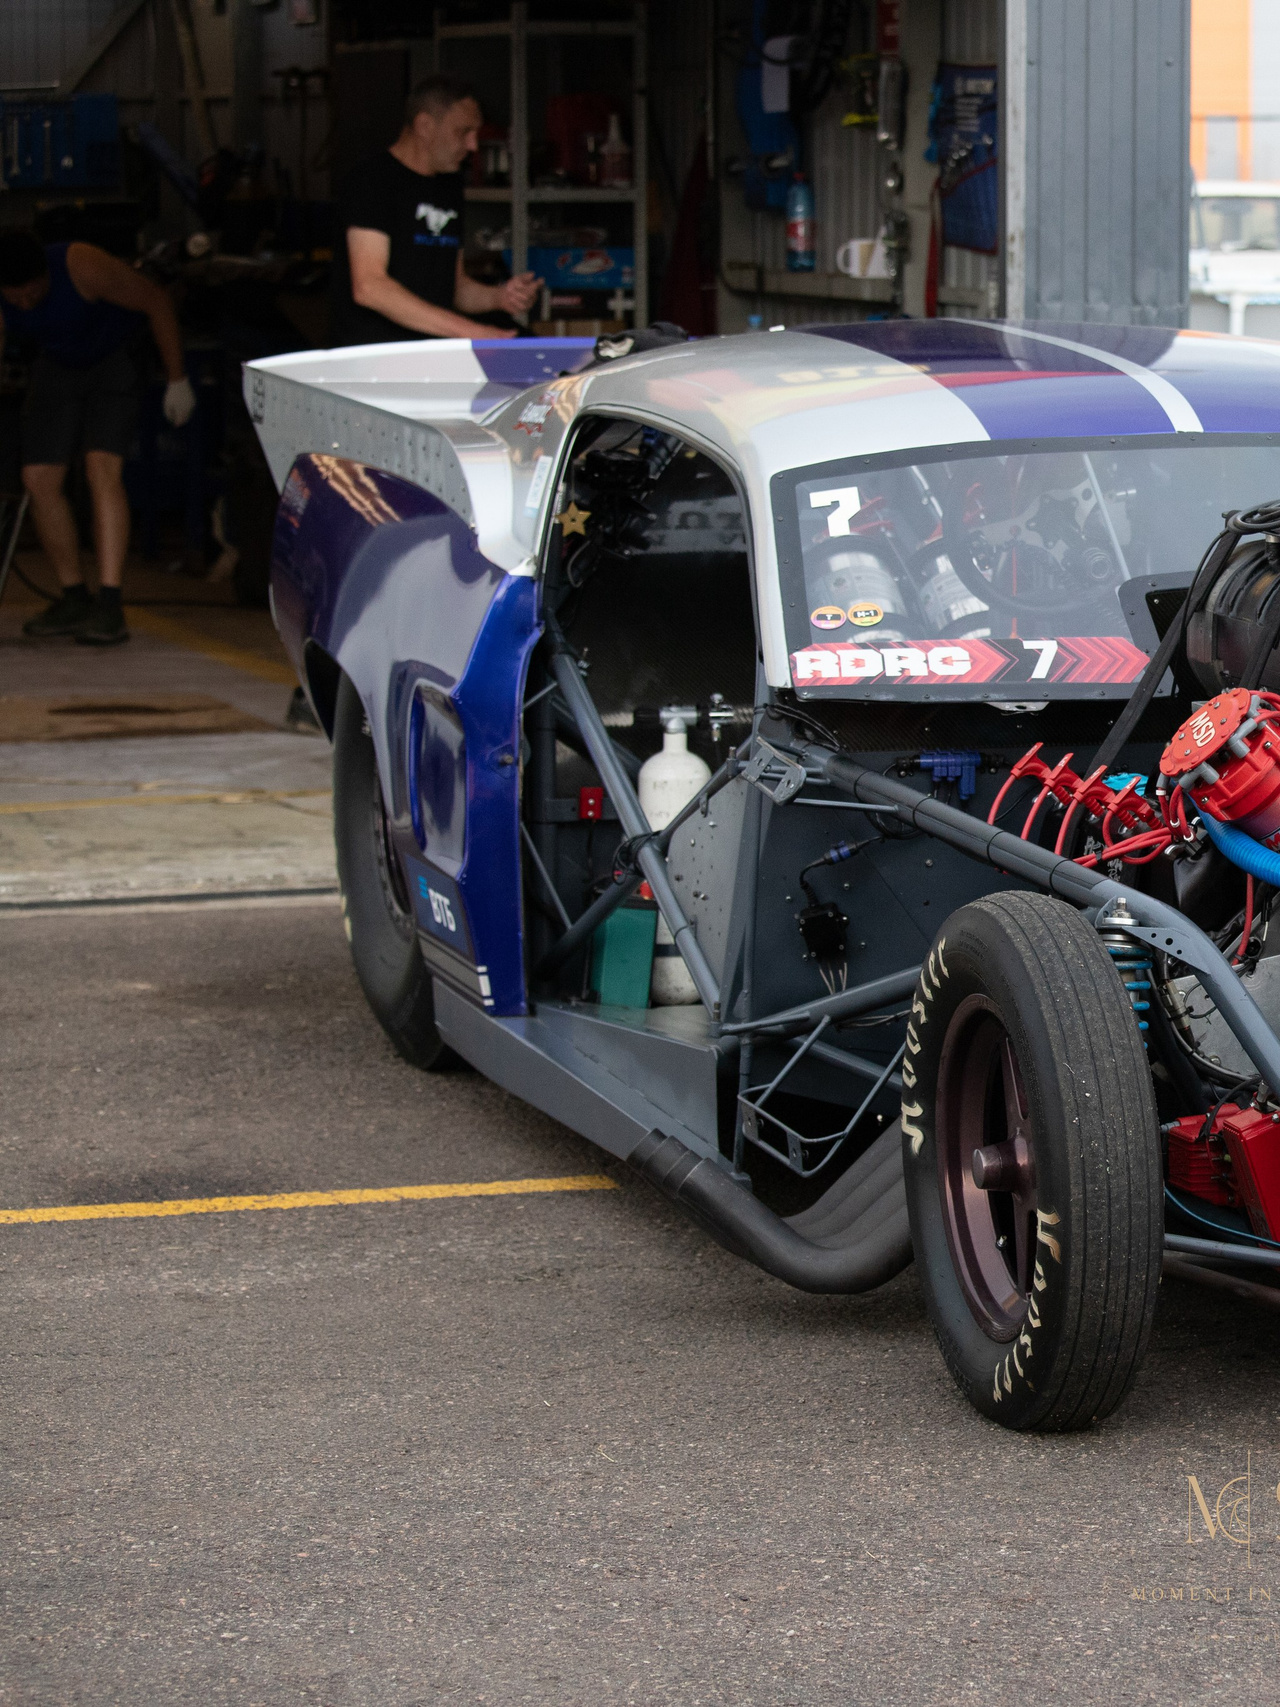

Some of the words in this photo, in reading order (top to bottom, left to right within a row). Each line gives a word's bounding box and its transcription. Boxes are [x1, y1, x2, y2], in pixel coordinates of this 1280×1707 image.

[809, 486, 861, 538] 7
[794, 647, 972, 679] RDRC
[1022, 640, 1060, 680] 7
[1189, 710, 1216, 748] MSD
[428, 888, 457, 932] ВТБ
